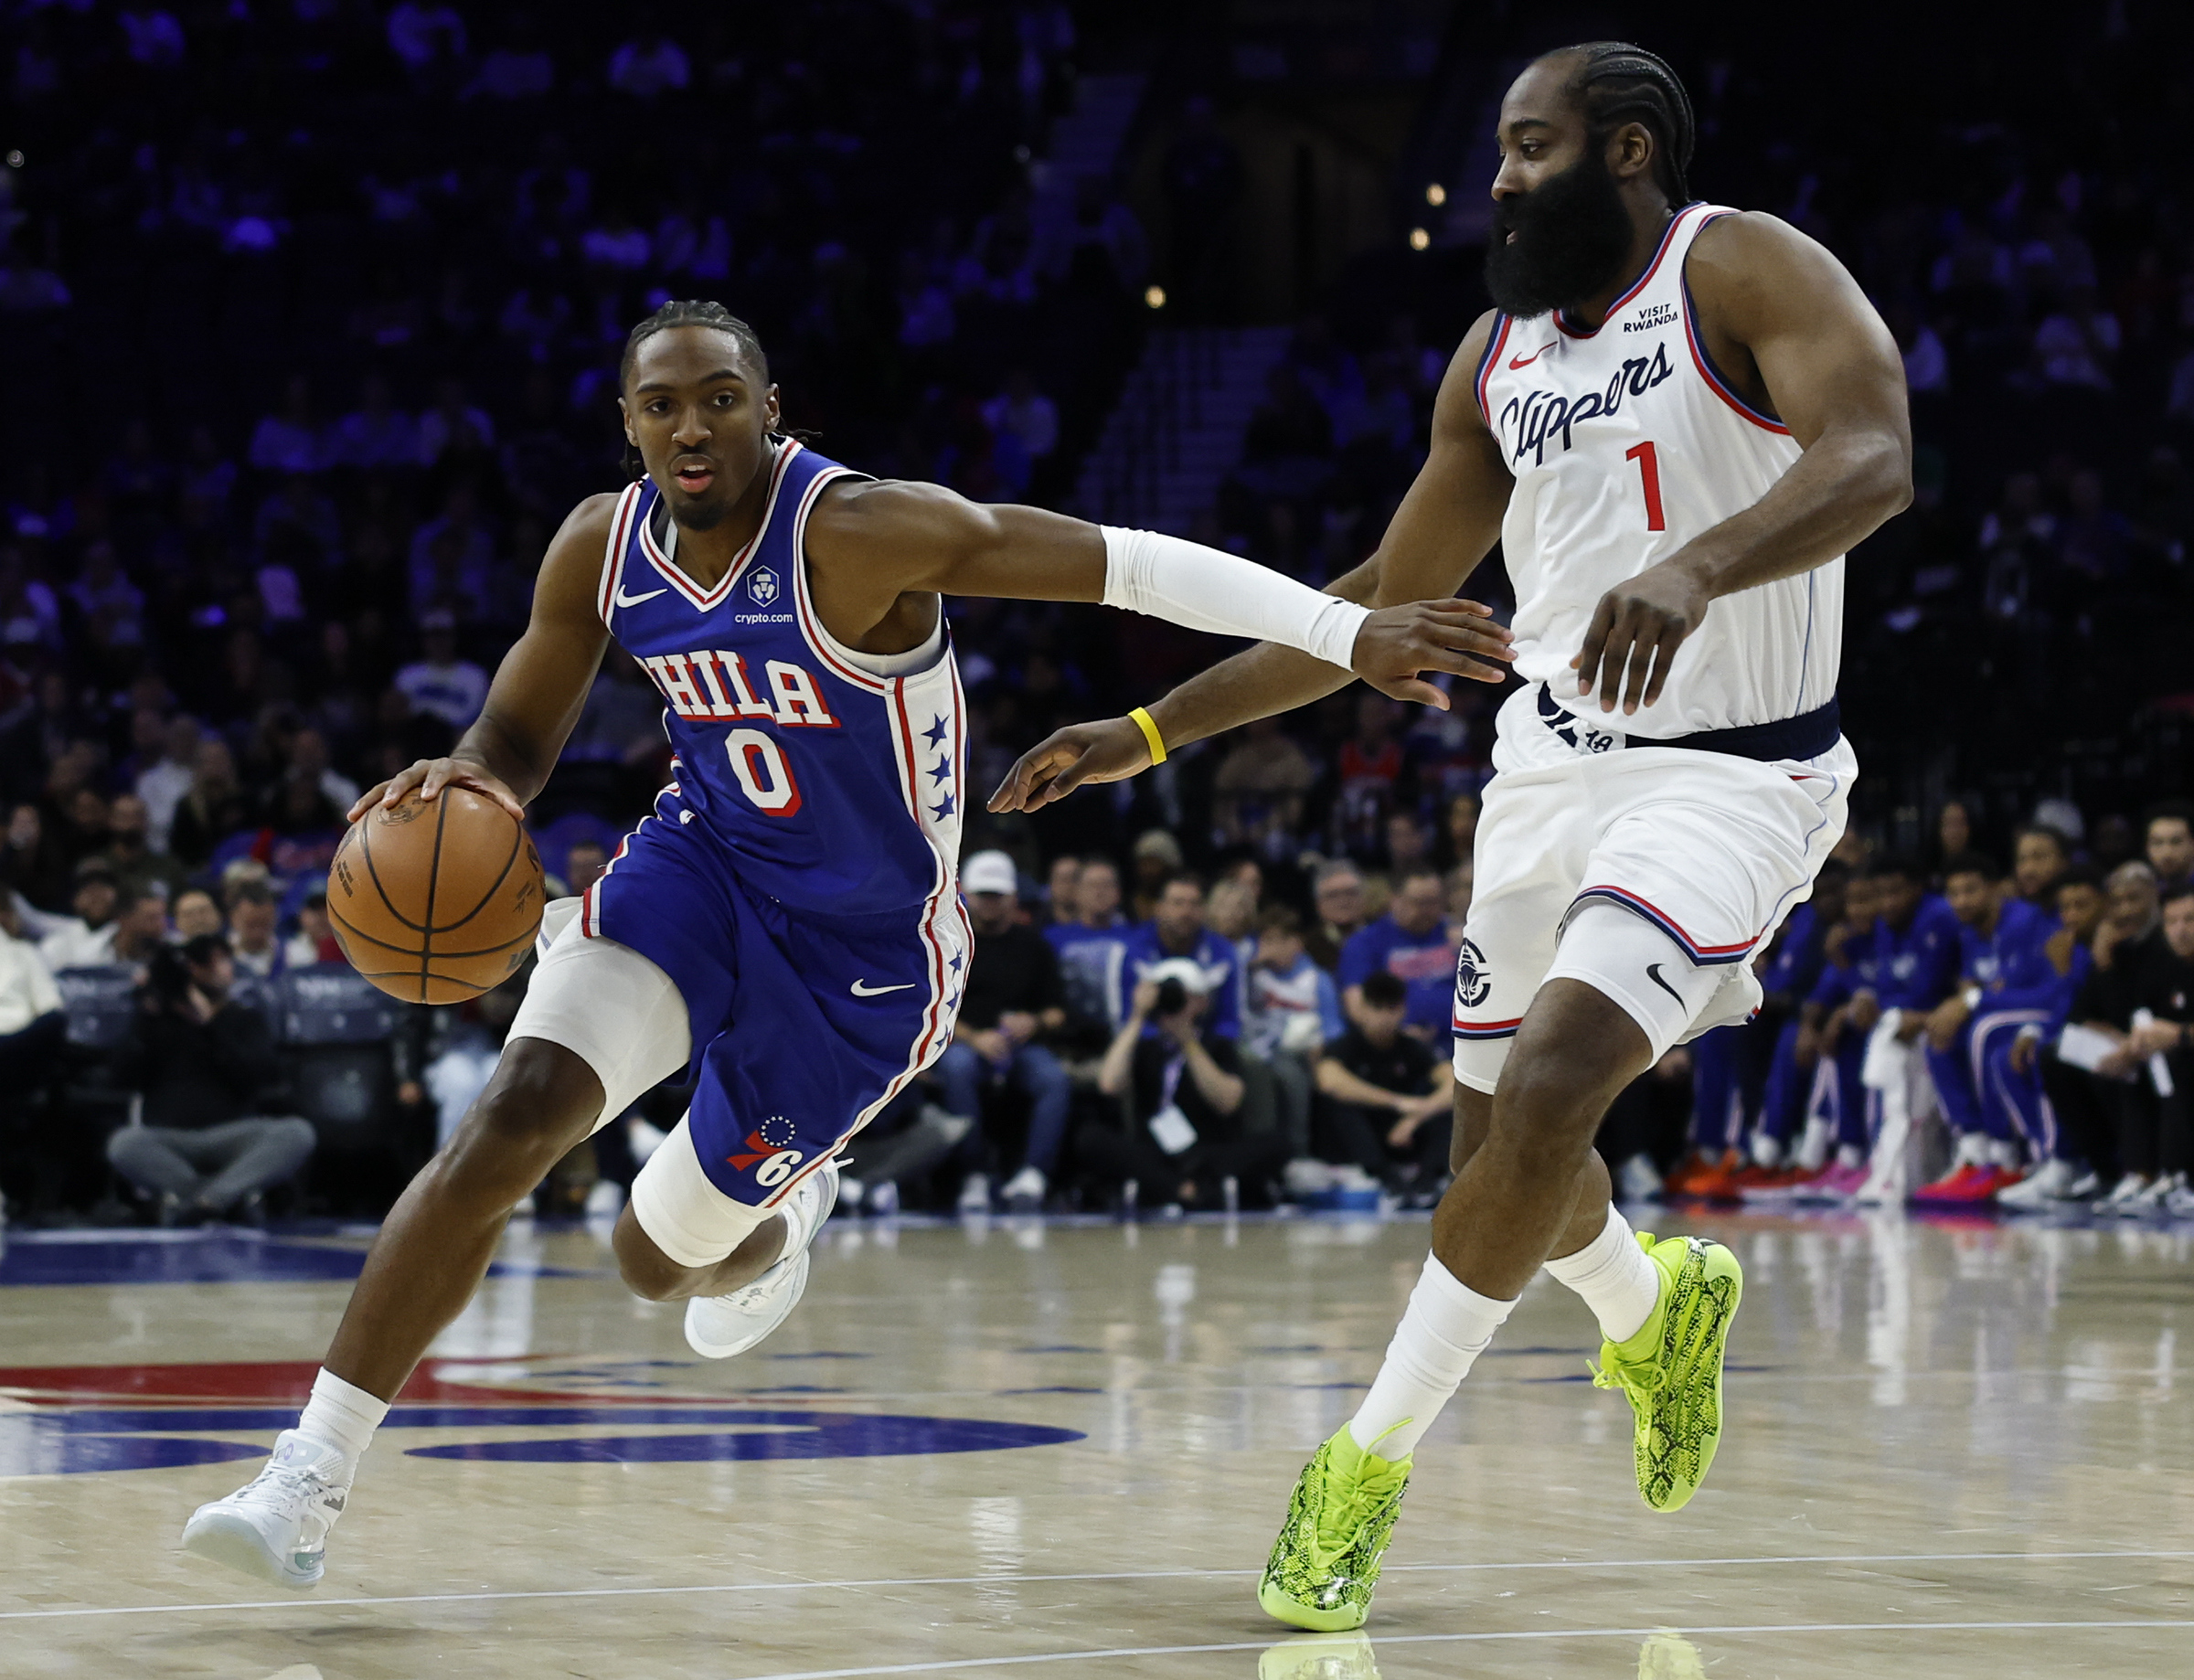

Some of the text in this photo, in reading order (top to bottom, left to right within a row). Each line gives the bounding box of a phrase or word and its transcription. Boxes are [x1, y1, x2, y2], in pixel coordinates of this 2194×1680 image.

[1623, 311, 1678, 333] RWANDA
[1639, 303, 1671, 320] VISIT
[1500, 341, 1675, 468] Clippers
[1625, 441, 1666, 531] 1
[734, 612, 793, 625] crypto.com
[633, 650, 842, 728] HILA
[724, 728, 803, 816] 0
